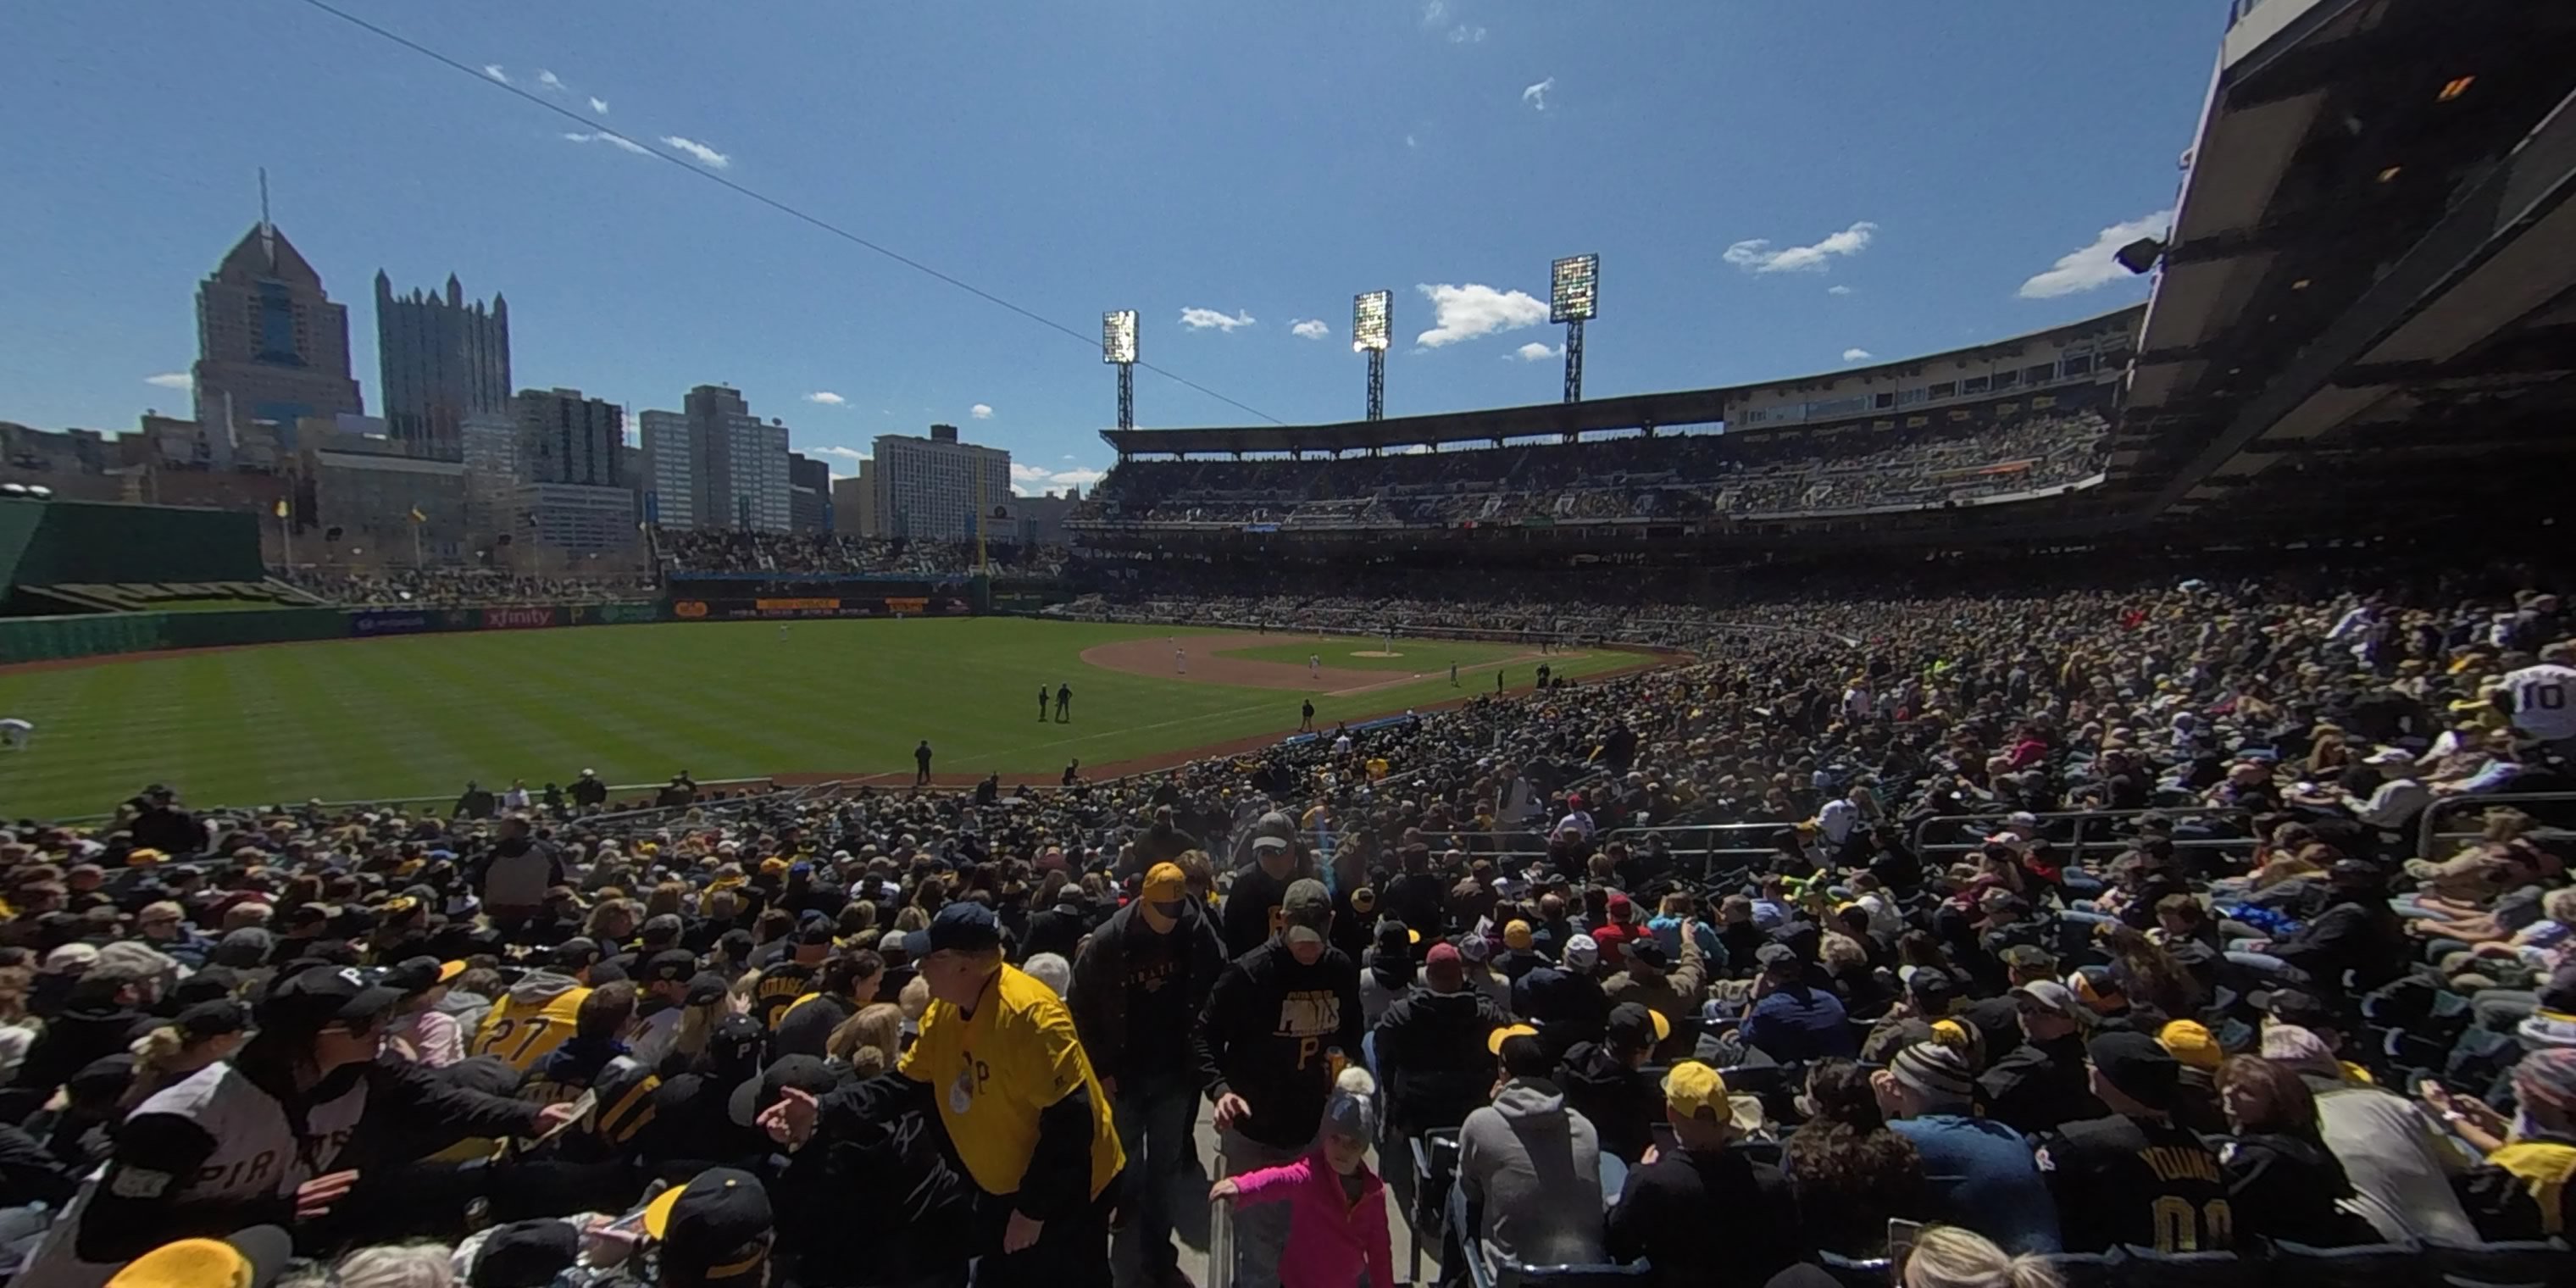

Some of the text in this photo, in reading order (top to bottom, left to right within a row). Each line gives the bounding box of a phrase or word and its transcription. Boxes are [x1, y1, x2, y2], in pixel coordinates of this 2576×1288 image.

[489, 608, 551, 627] xfinity
[2523, 681, 2564, 709] 10
[339, 967, 364, 986] P
[483, 1019, 549, 1062] 27
[736, 1042, 752, 1059] P
[1297, 1035, 1319, 1072] P
[975, 1061, 990, 1096] P
[193, 1130, 353, 1191] PIRATE
[2137, 1146, 2221, 1184] YOUNG
